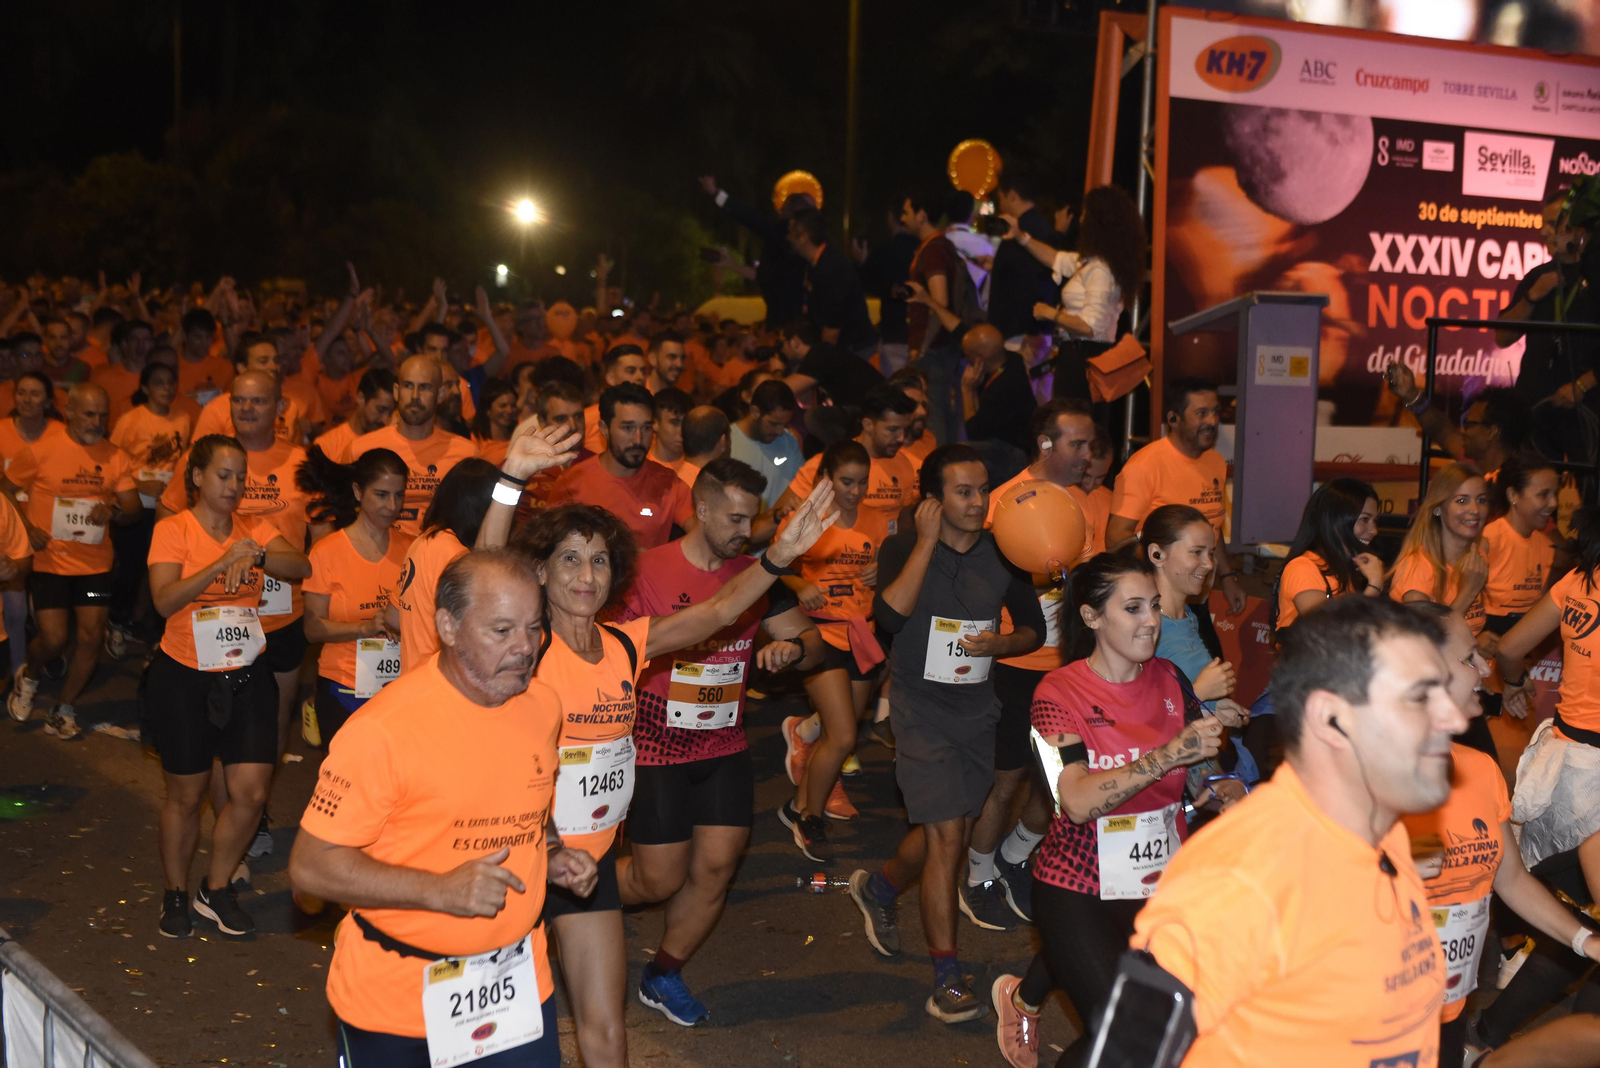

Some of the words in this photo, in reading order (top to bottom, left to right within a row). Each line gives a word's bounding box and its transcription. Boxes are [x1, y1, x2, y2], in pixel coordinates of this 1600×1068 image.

[1301, 58, 1337, 80] ABC
[1355, 68, 1430, 95] Cruzcampo
[1443, 80, 1475, 97] TORRE
[1477, 84, 1518, 101] SEVILLA
[1396, 138, 1415, 152] IMD
[1418, 201, 1438, 221] 30
[1439, 203, 1459, 223] de
[1460, 206, 1543, 230] septiembre
[1368, 231, 1476, 278] XXXIV
[1367, 344, 1402, 374] del
[216, 626, 251, 643] 4894
[697, 686, 723, 703] 560
[567, 712, 614, 724] SEVILLA
[578, 768, 625, 798] 12463
[453, 820, 465, 829] EL
[490, 817, 500, 827] DE
[502, 814, 517, 826] LAS
[452, 838, 471, 851] ES
[473, 830, 537, 852] COMPARTIR
[1129, 836, 1170, 863] 4421
[449, 975, 516, 1020] 21805
